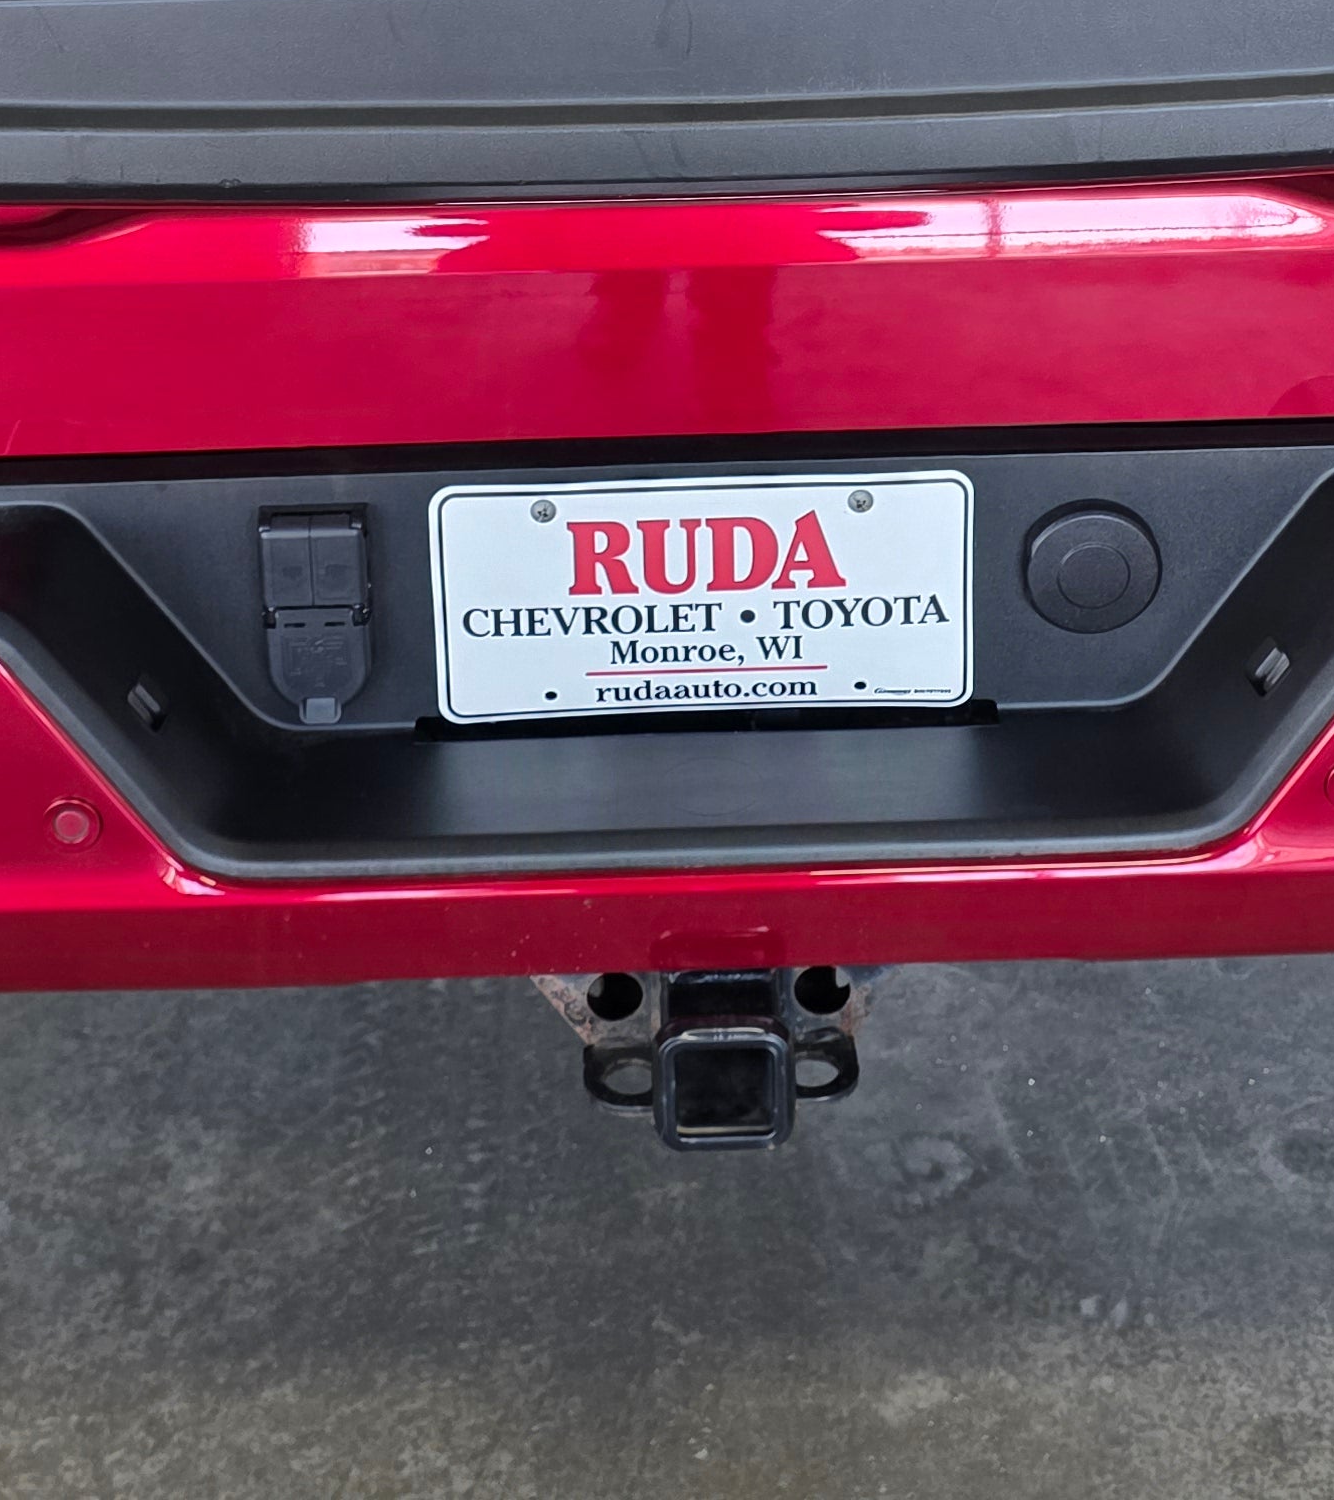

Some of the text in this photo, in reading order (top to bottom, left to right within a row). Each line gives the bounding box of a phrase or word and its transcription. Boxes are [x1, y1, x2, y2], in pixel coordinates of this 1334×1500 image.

[566, 509, 847, 596] RUDA
[461, 594, 950, 638] CHEVROLET TOYOTA
[608, 635, 804, 667] Monroe, WI
[594, 678, 819, 704] rudaauto.com
